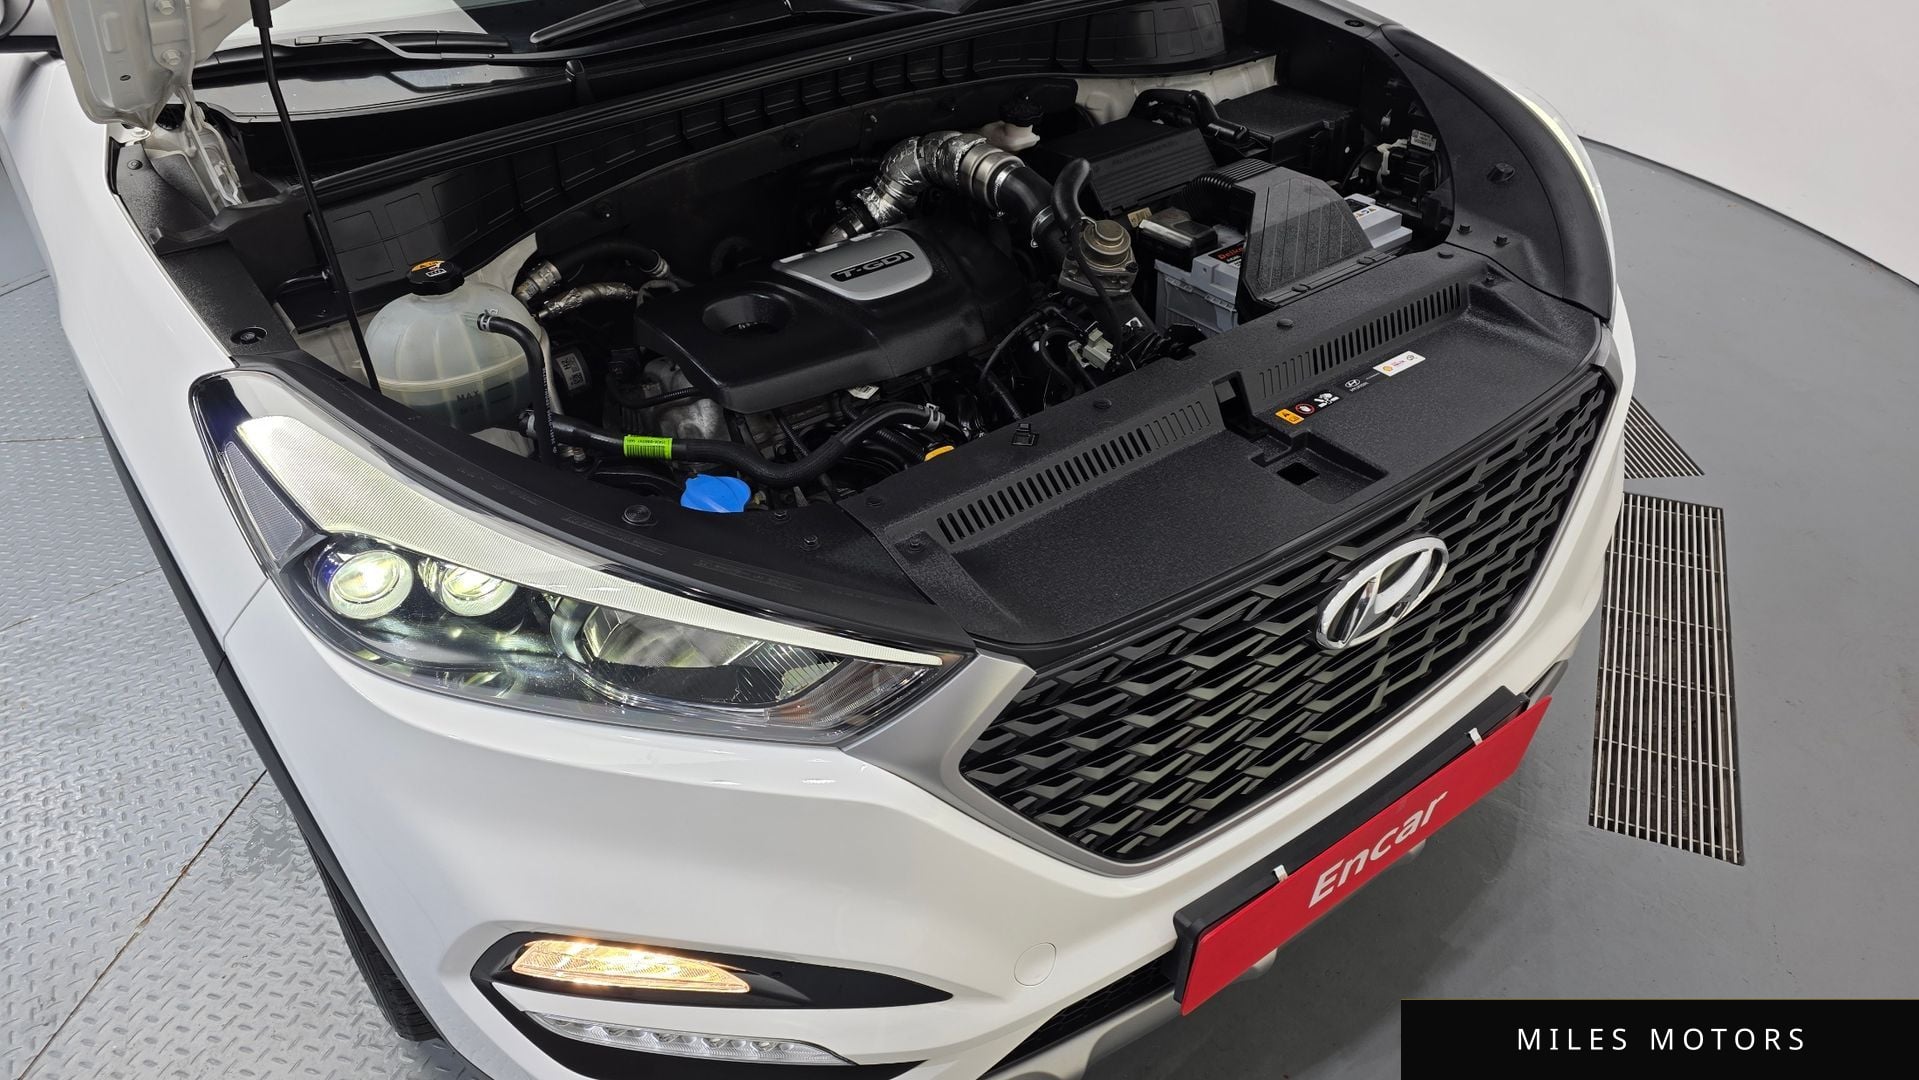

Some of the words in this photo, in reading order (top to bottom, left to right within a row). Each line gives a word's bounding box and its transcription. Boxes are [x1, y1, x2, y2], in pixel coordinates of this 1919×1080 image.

[837, 252, 909, 278] T-GDI
[456, 390, 479, 401] MAX
[1308, 791, 1448, 909] Encar
